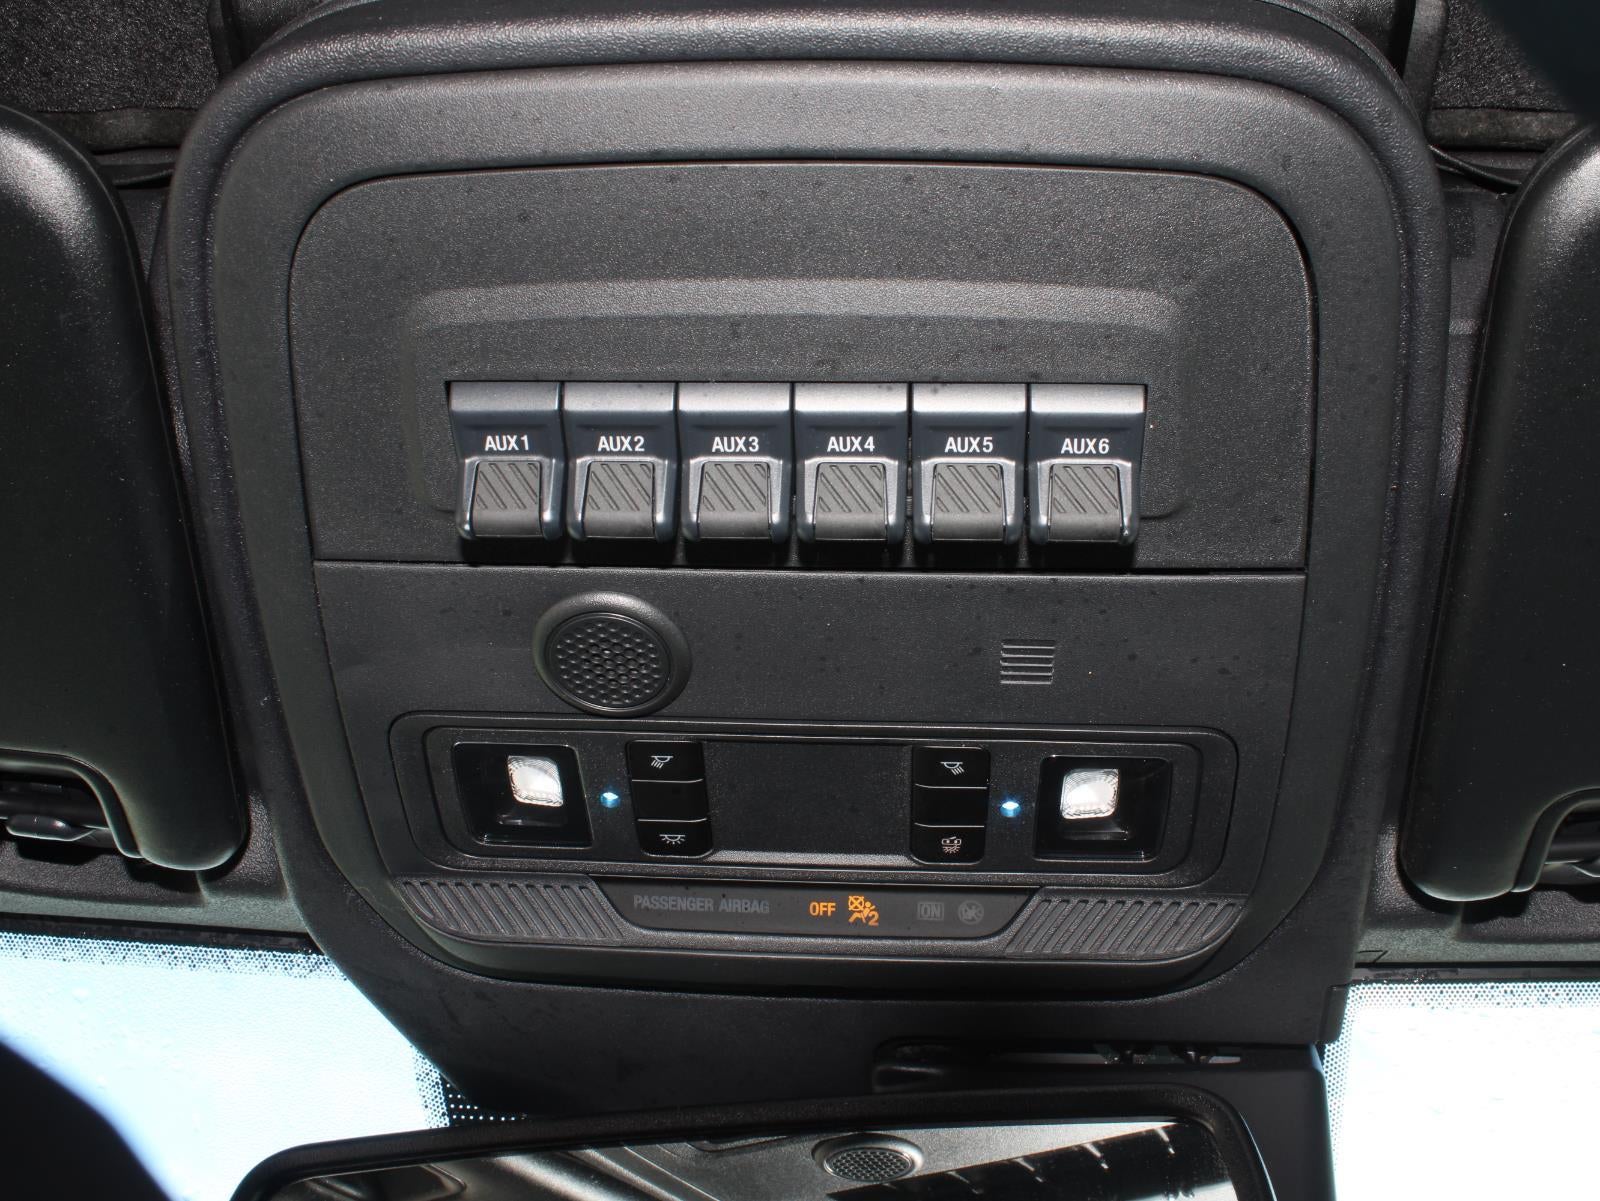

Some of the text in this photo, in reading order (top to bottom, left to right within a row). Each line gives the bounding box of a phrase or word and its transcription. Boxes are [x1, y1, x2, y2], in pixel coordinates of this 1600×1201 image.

[485, 435, 530, 451] AUX1
[597, 436, 645, 452] AUX2
[711, 436, 760, 453] AUX3
[827, 436, 875, 452] AUX4
[945, 437, 993, 453] AUX5
[1061, 438, 1110, 454] AUX6
[633, 895, 770, 914] PASSENGER AIRBAG
[809, 901, 837, 917] OFF
[920, 903, 941, 919] ON
[868, 910, 879, 927] 2
